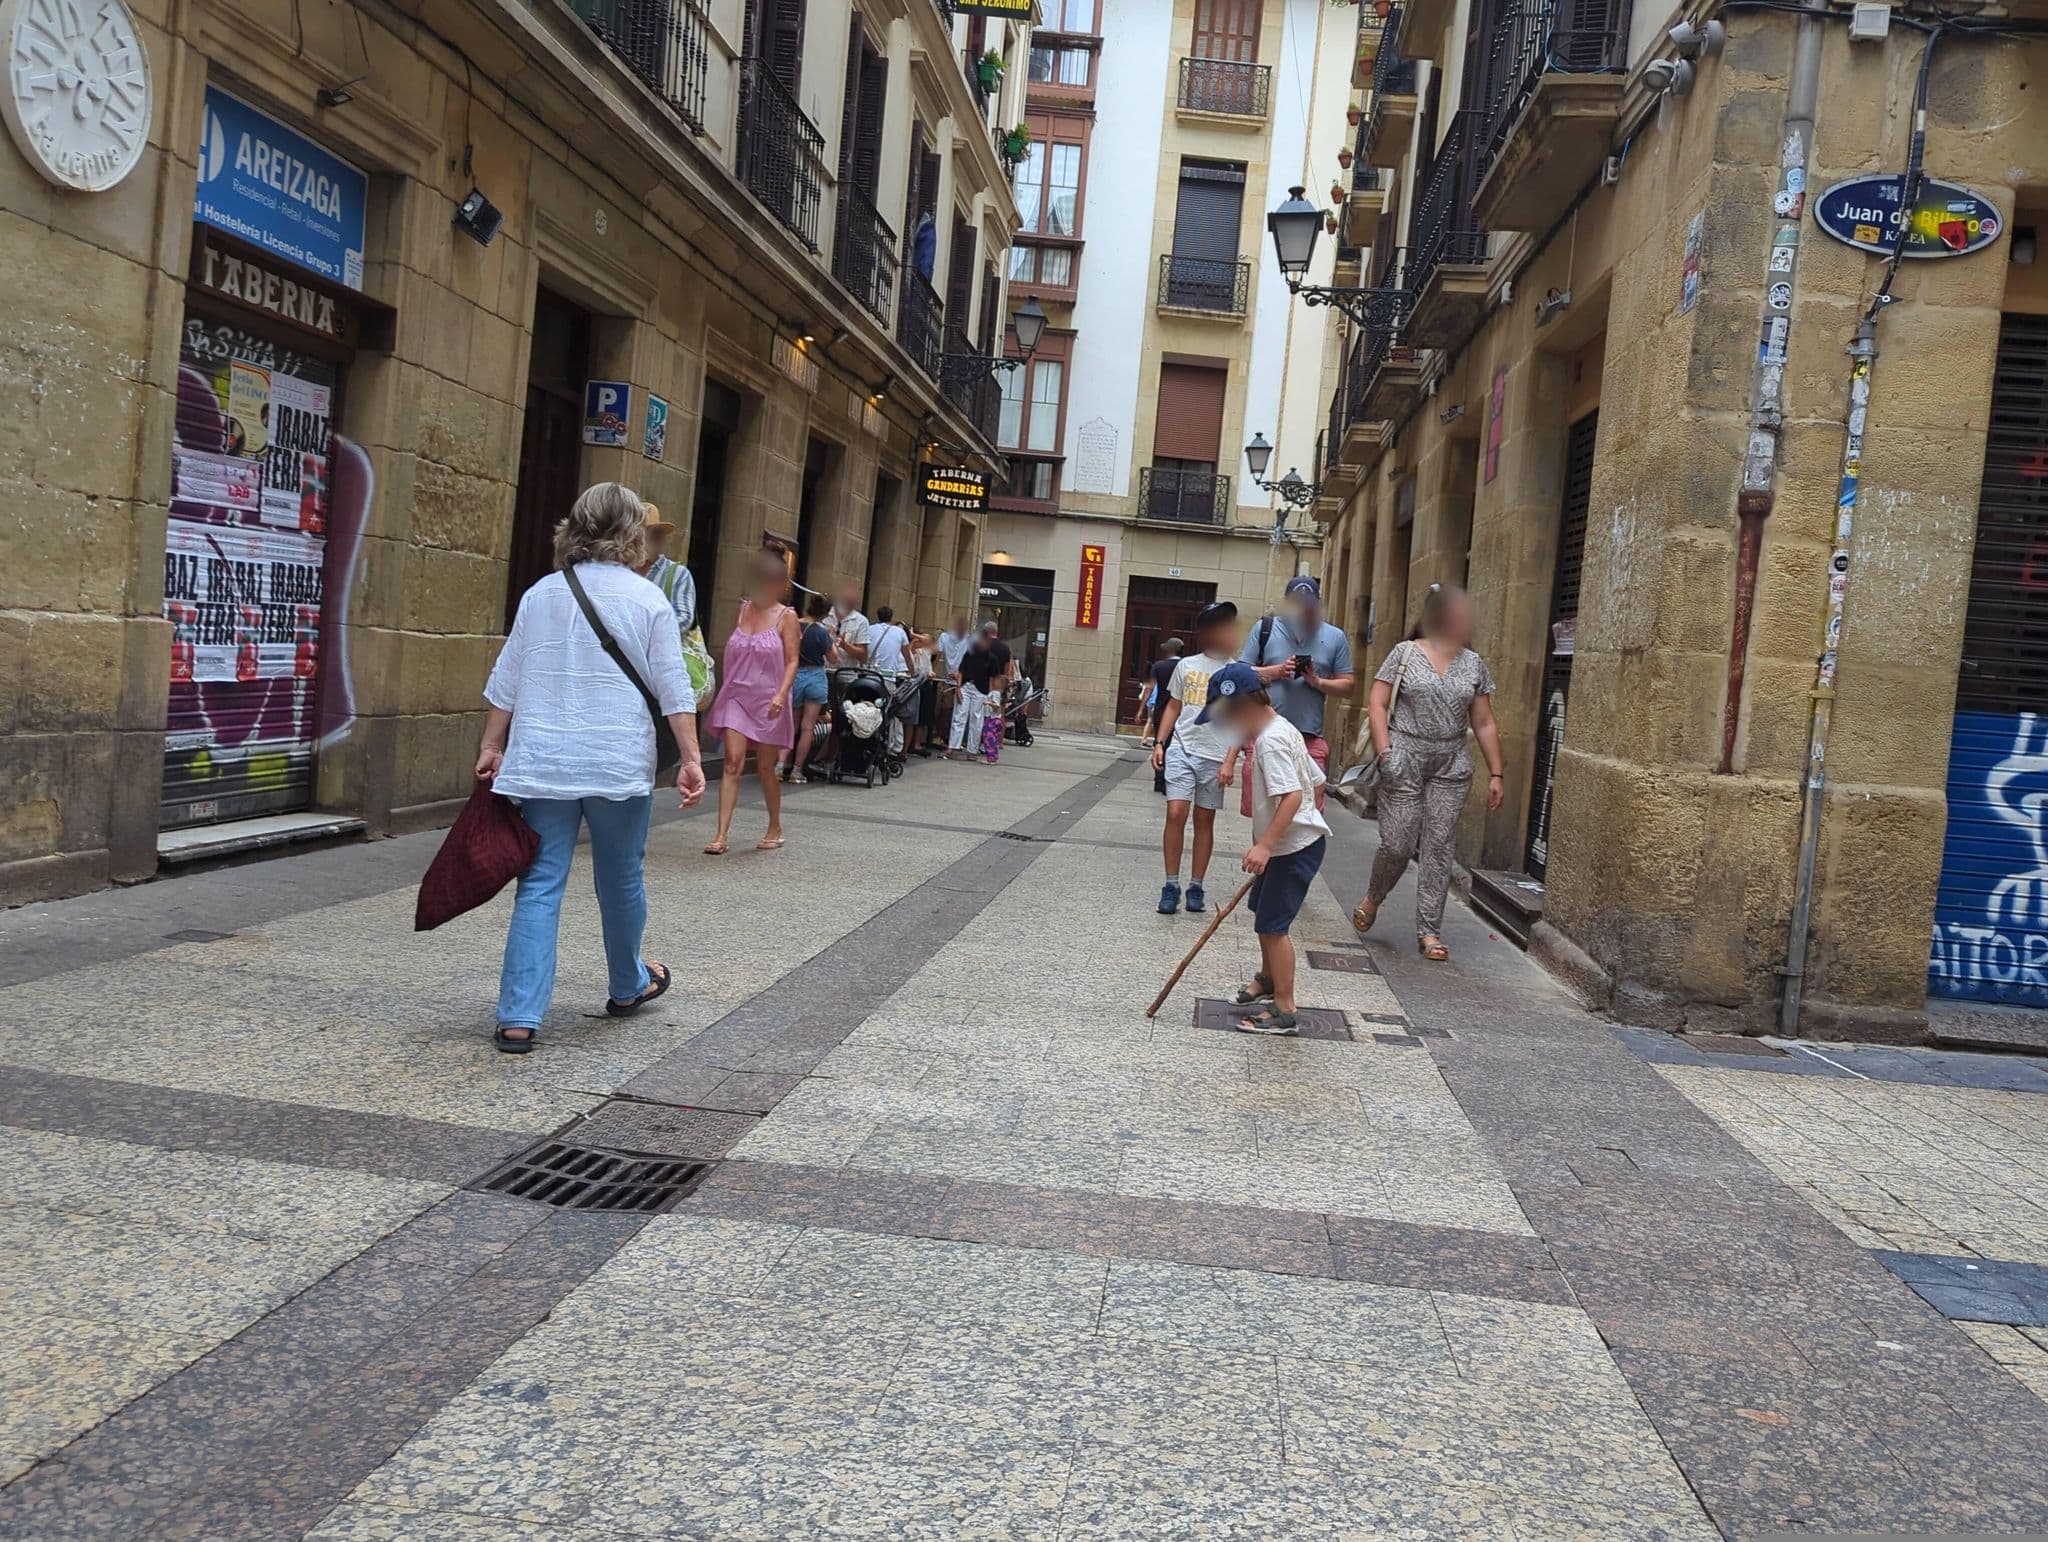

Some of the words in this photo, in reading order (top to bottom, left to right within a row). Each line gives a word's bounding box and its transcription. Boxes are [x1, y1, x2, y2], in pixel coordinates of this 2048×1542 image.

[234, 131, 341, 223] AREIZAGA
[1836, 202, 1884, 223] Juan
[1920, 210, 1979, 233] Bilbo
[262, 230, 304, 260] Licencia
[305, 251, 333, 273] Grupo
[334, 264, 340, 277] 3
[203, 245, 336, 335] TABERNA
[598, 387, 618, 413] P
[264, 445, 302, 494] TERA
[933, 469, 982, 484] TABERNA
[927, 493, 980, 509] JATETXEA
[271, 561, 323, 605] IRABAZ
[1082, 567, 1095, 625] TABAKOAK
[195, 602, 237, 646] TERA
[260, 603, 297, 645] TERA
